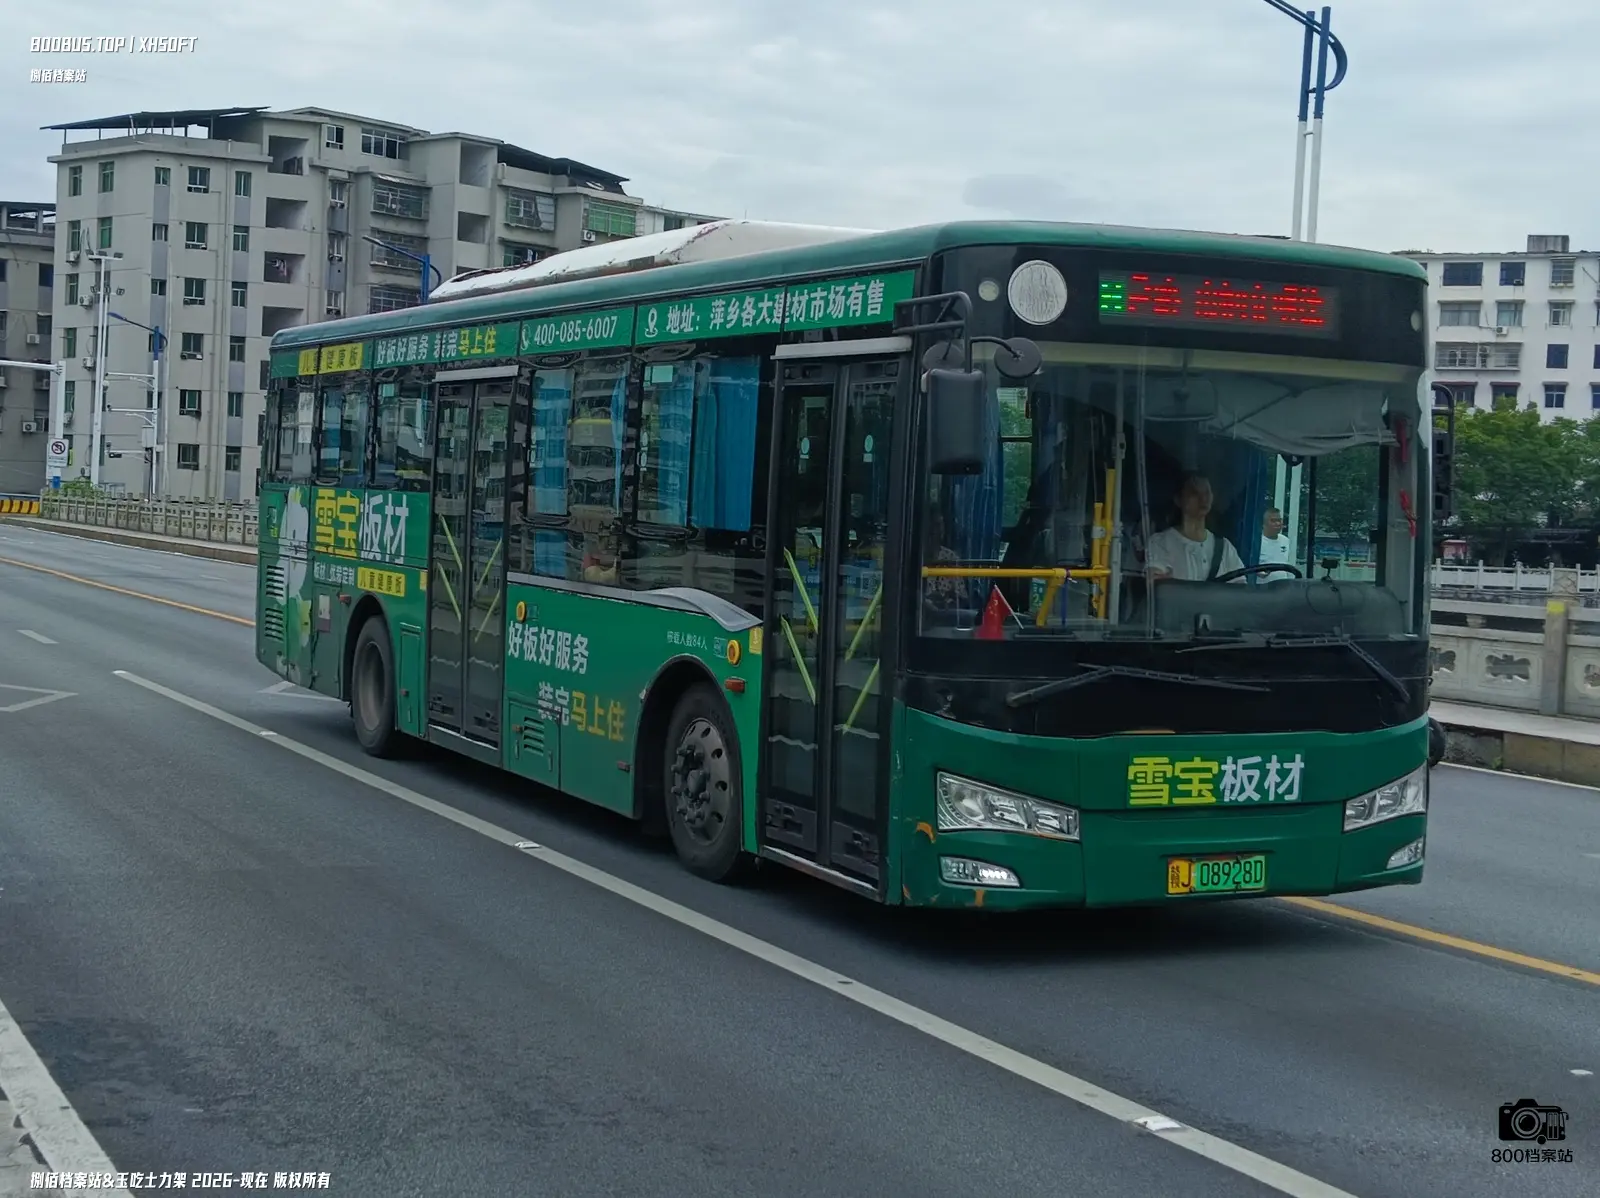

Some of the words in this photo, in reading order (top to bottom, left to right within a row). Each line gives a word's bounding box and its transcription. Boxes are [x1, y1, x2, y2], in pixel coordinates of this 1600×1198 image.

[534, 315, 618, 346] 400-085-6007
[314, 488, 410, 564] 雪宝板材
[508, 621, 589, 675] 好板好服务
[537, 681, 626, 742] 装完马上住
[1128, 754, 1305, 806] 雪宝板材
